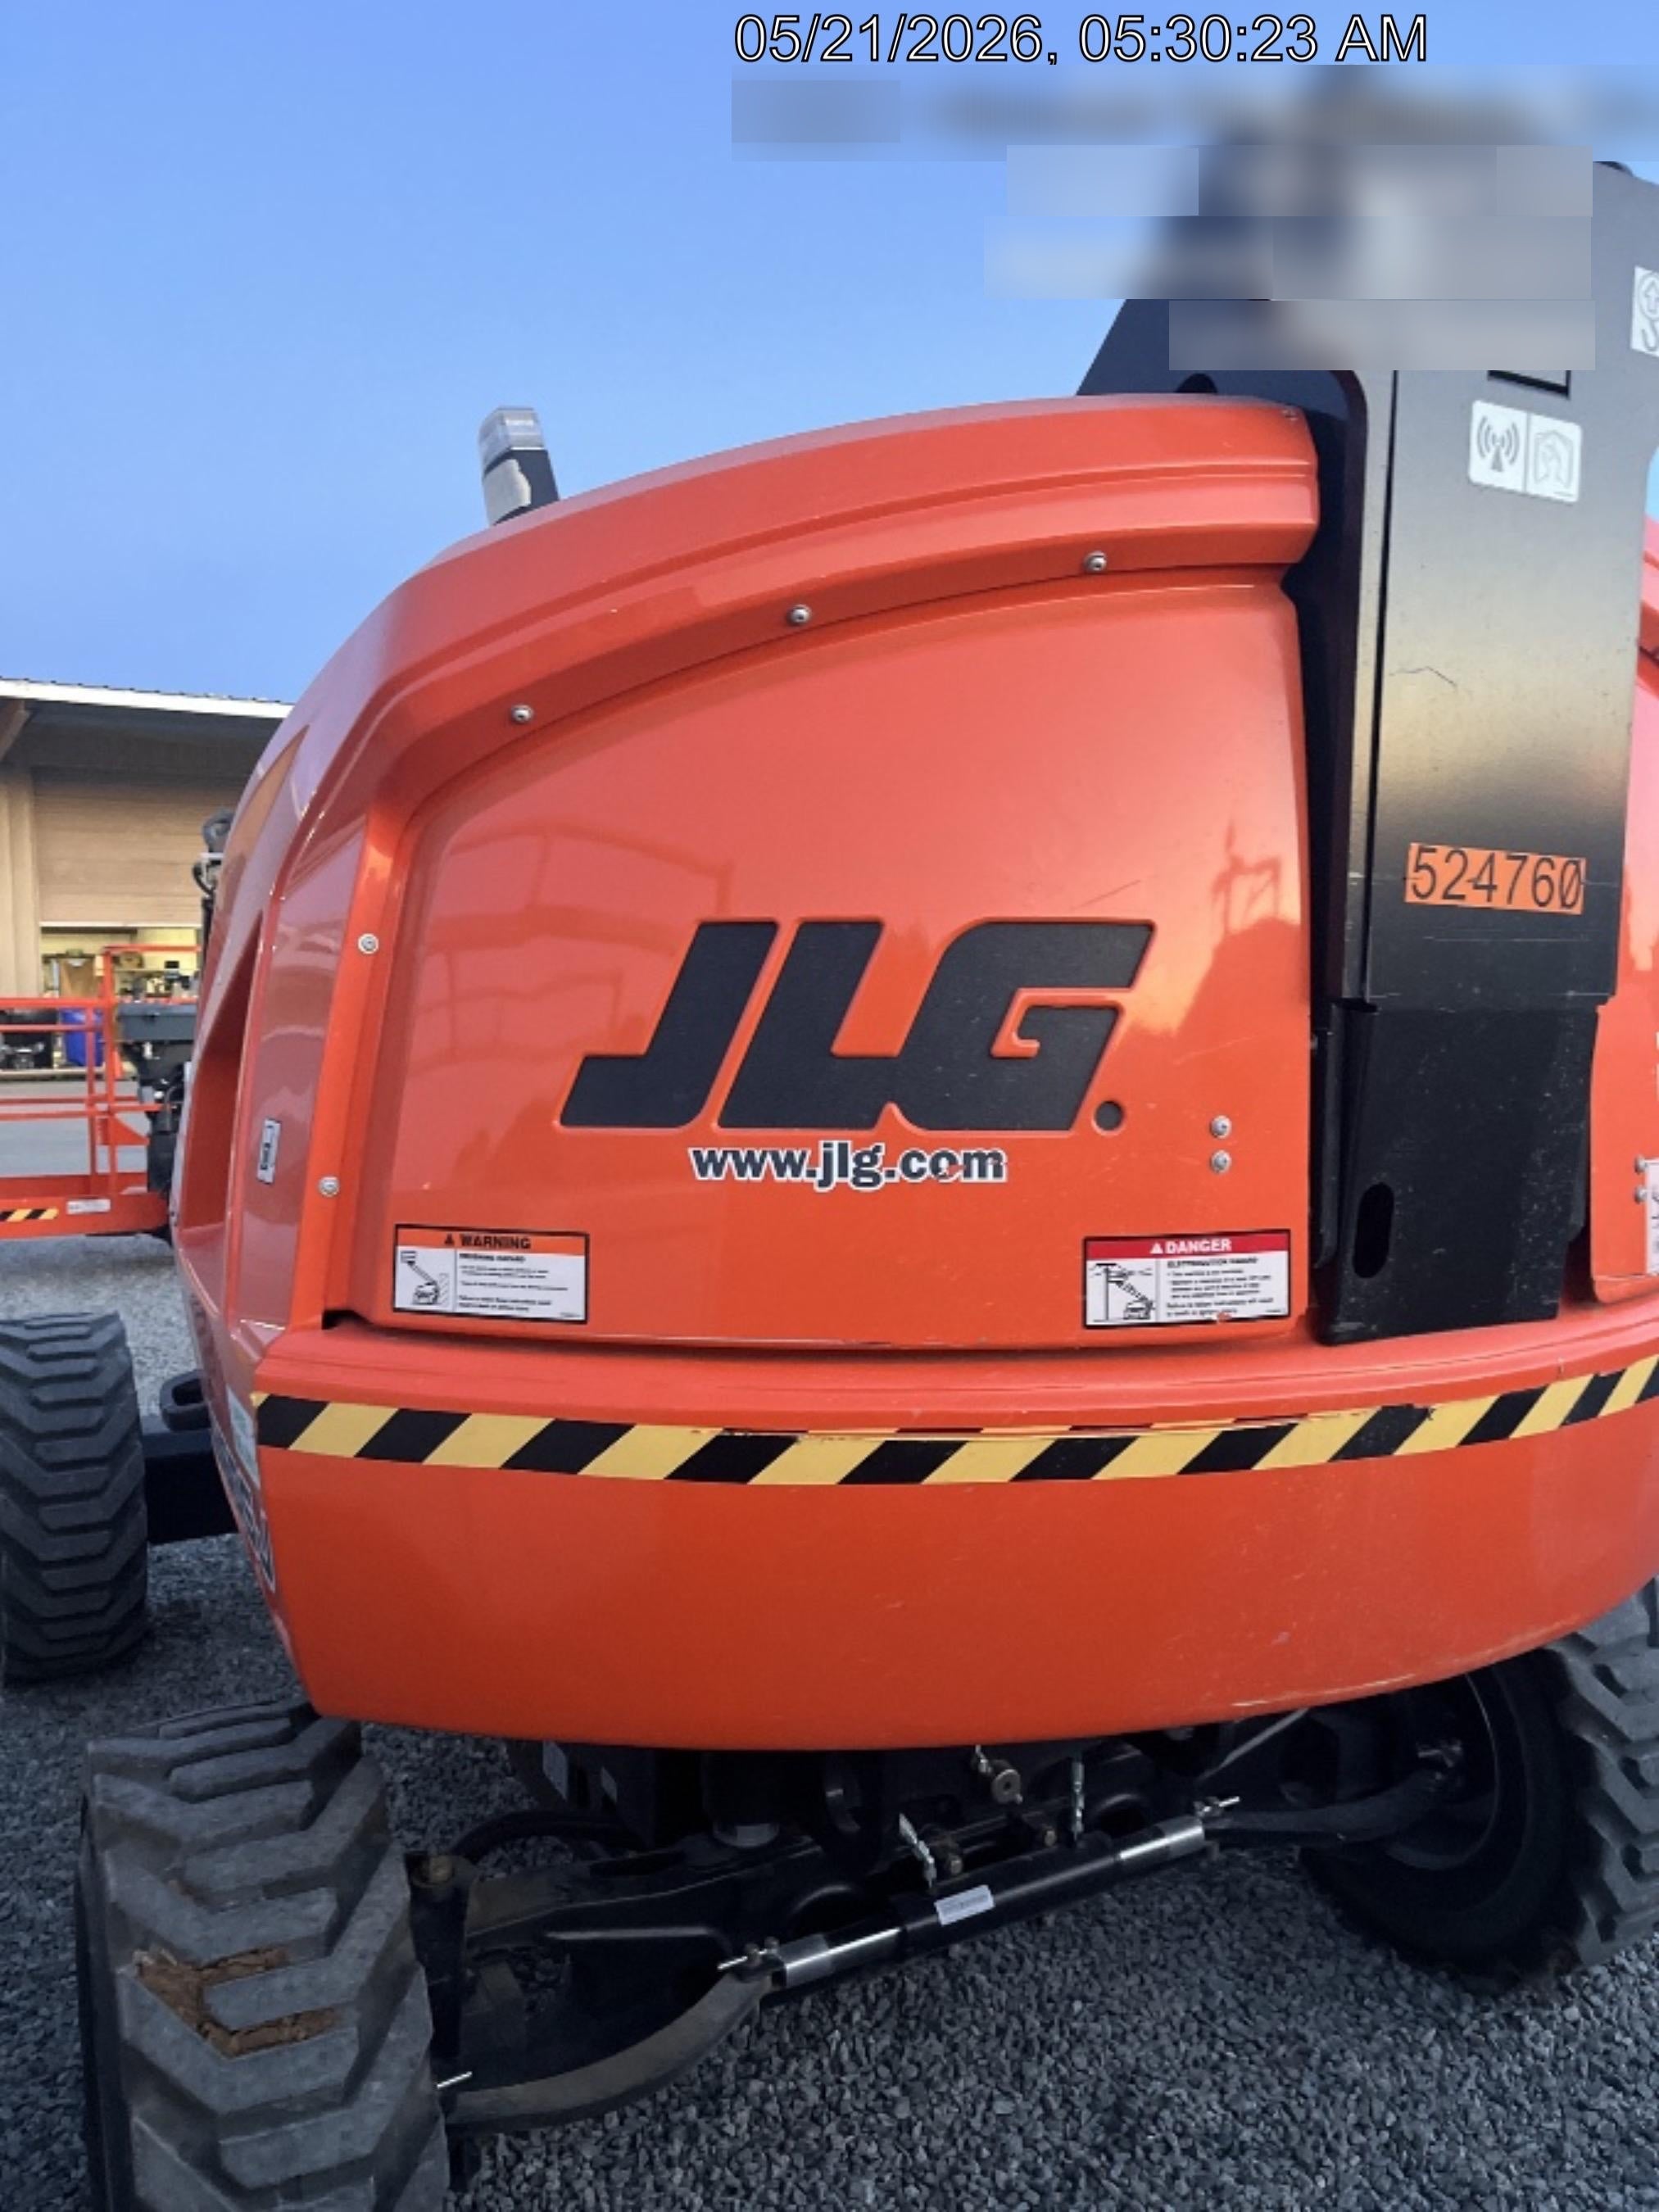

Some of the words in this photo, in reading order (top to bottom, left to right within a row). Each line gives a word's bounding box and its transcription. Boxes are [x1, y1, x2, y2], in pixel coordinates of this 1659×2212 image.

[1412, 845, 1582, 909] 524760
[690, 1140, 1007, 1191] www.jlg.com
[460, 1233, 531, 1249] WARNING
[1165, 1238, 1233, 1254] DANGER
